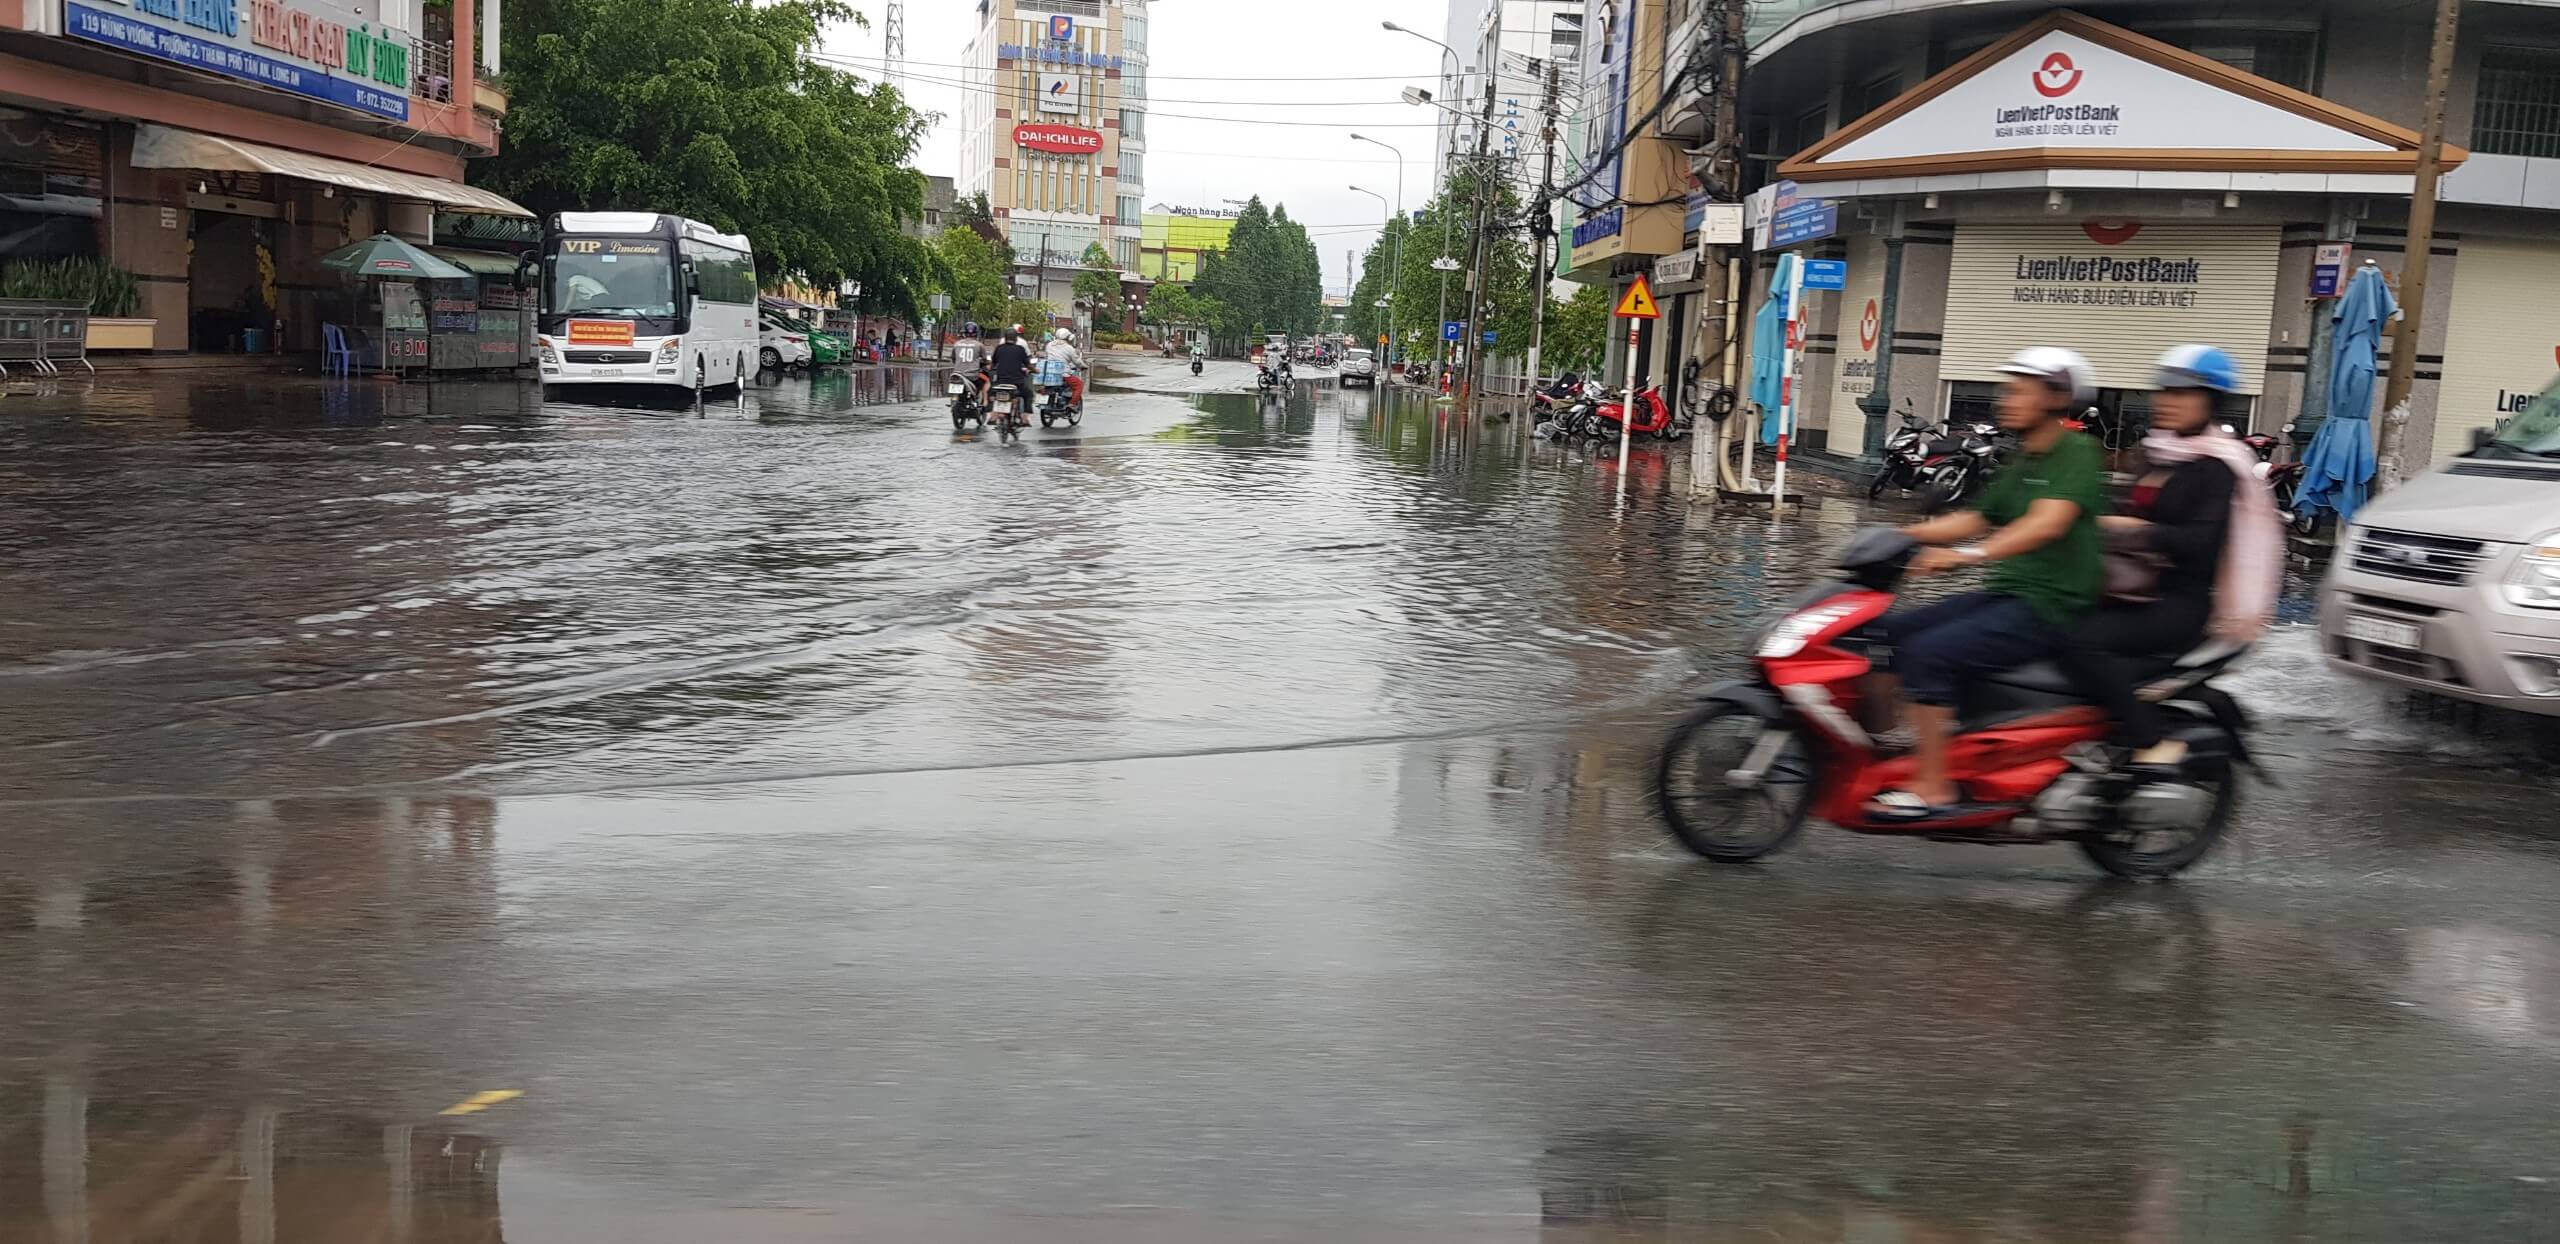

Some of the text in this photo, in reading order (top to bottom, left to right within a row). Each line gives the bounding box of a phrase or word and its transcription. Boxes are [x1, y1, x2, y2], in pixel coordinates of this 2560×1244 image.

[81, 13, 99, 33] 119
[1019, 131, 1097, 147] DAI-ICHI LIFE
[564, 240, 602, 253] VIP
[2016, 254, 2201, 283] LienVietPostBank
[2014, 284, 2198, 307] NGÂN HÀNG BƯU ĐIỆN LIÊN VIỆT
[1448, 326, 1456, 336] P
[959, 348, 974, 362] 40
